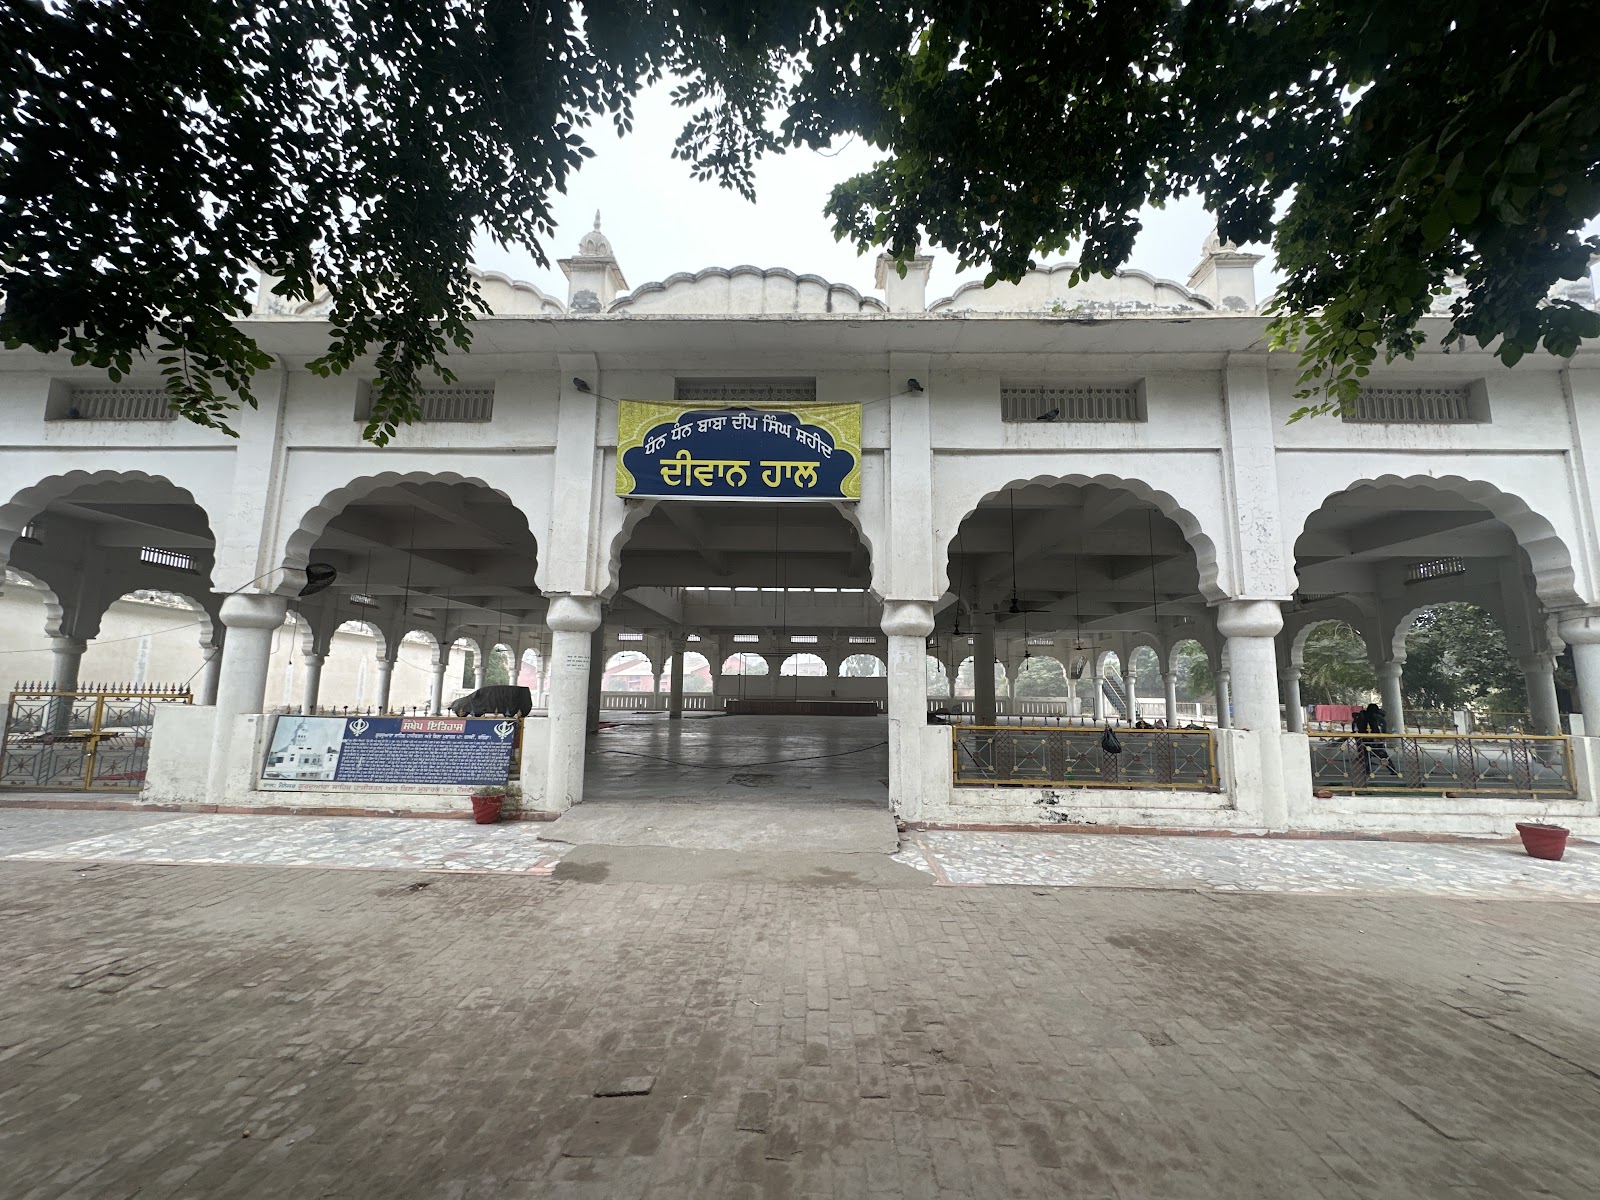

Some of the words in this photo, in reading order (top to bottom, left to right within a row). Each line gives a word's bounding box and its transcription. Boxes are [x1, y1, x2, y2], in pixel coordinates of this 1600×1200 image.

[644, 432, 667, 455] ਧੰਨ
[671, 422, 693, 441] ਧੰਨ
[697, 416, 727, 433] ਬਾਬਾ
[731, 412, 758, 431] ਦੀਪ
[763, 414, 791, 439] ਸਿੰਘ
[795, 427, 832, 459] ਸ਼ਹੀਦ
[659, 449, 750, 487] ਦੀਵਾਨ
[759, 460, 820, 488] ਹਾਲ
[403, 719, 423, 731] ਸੰਖੇਪ
[427, 720, 464, 731] ਇਤਿਹਾਸ
